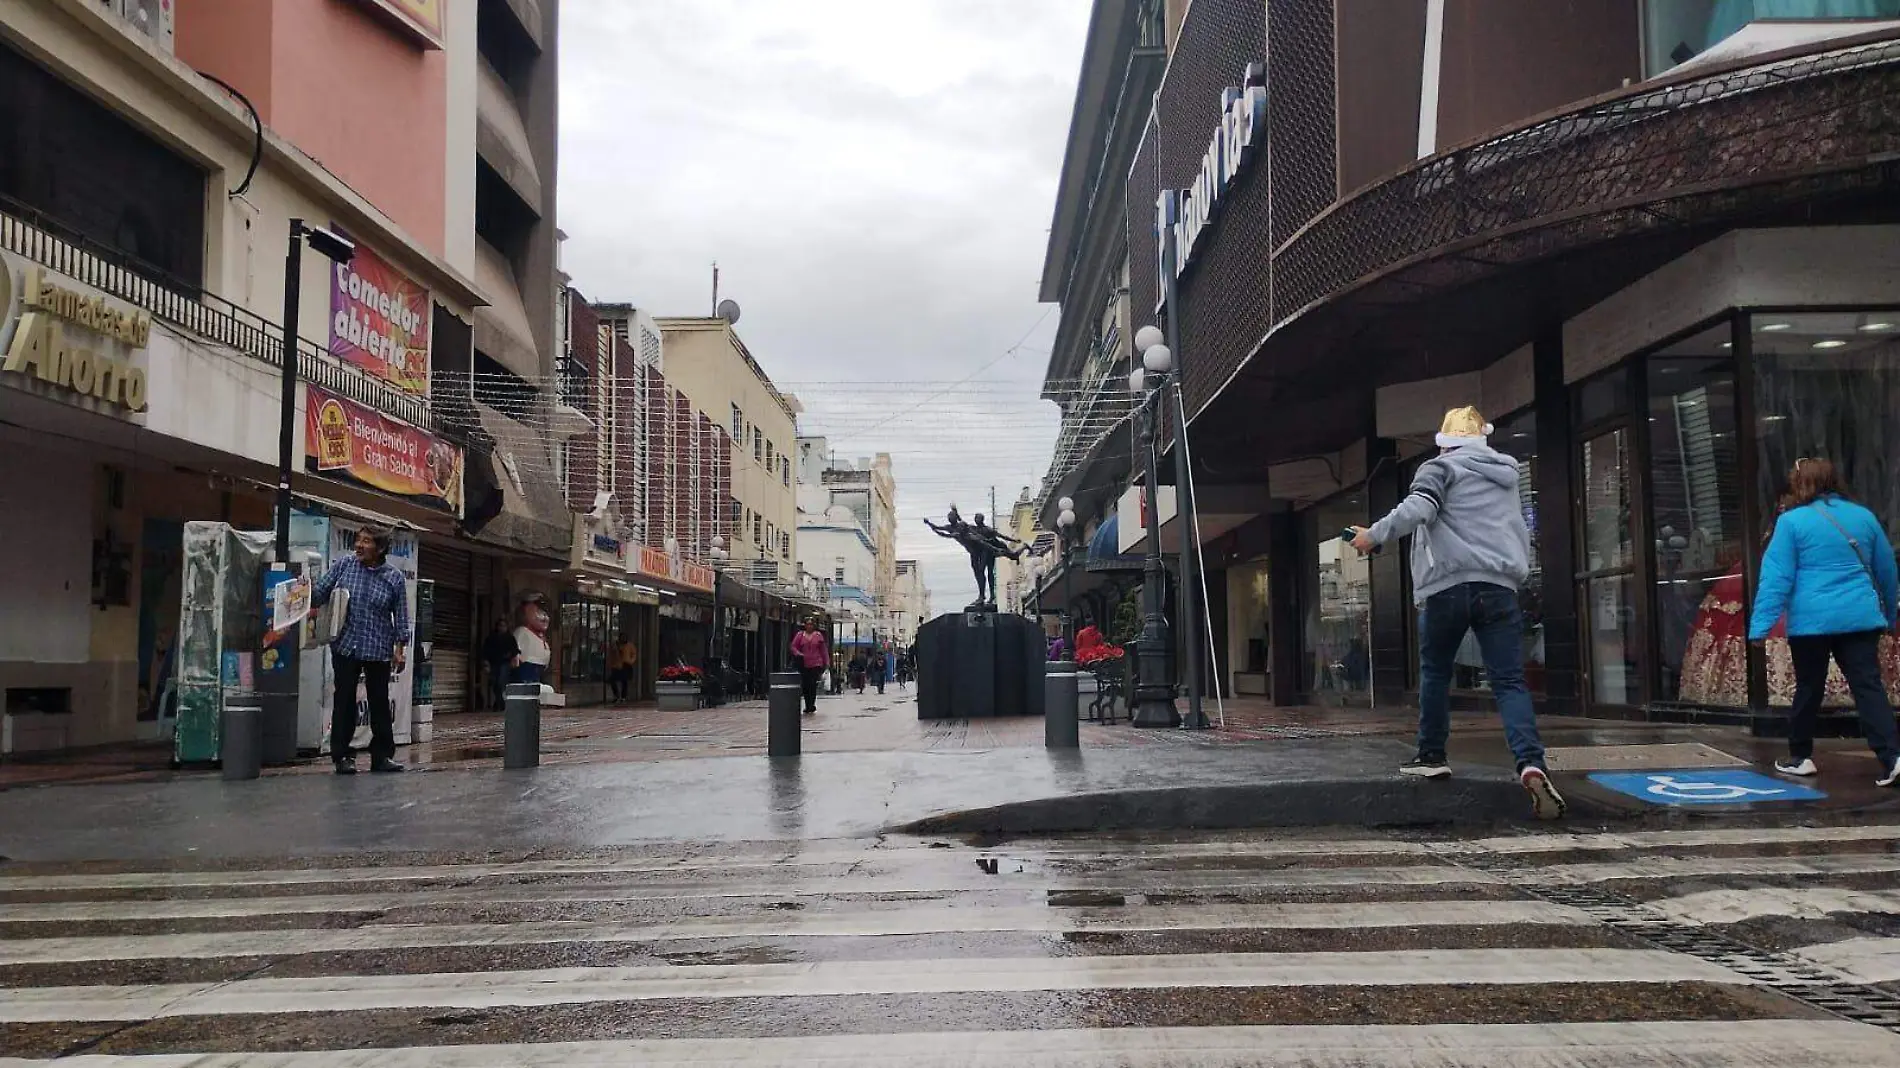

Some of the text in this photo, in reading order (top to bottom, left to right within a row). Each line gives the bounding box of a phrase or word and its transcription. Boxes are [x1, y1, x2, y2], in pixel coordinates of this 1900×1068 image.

[336, 260, 420, 336] Comedor
[3, 312, 147, 411] Ahorro
[334, 305, 406, 371] abierto
[354, 417, 407, 455] Bienvenido
[363, 444, 388, 469] Gran
[389, 452, 417, 479] Sabor
